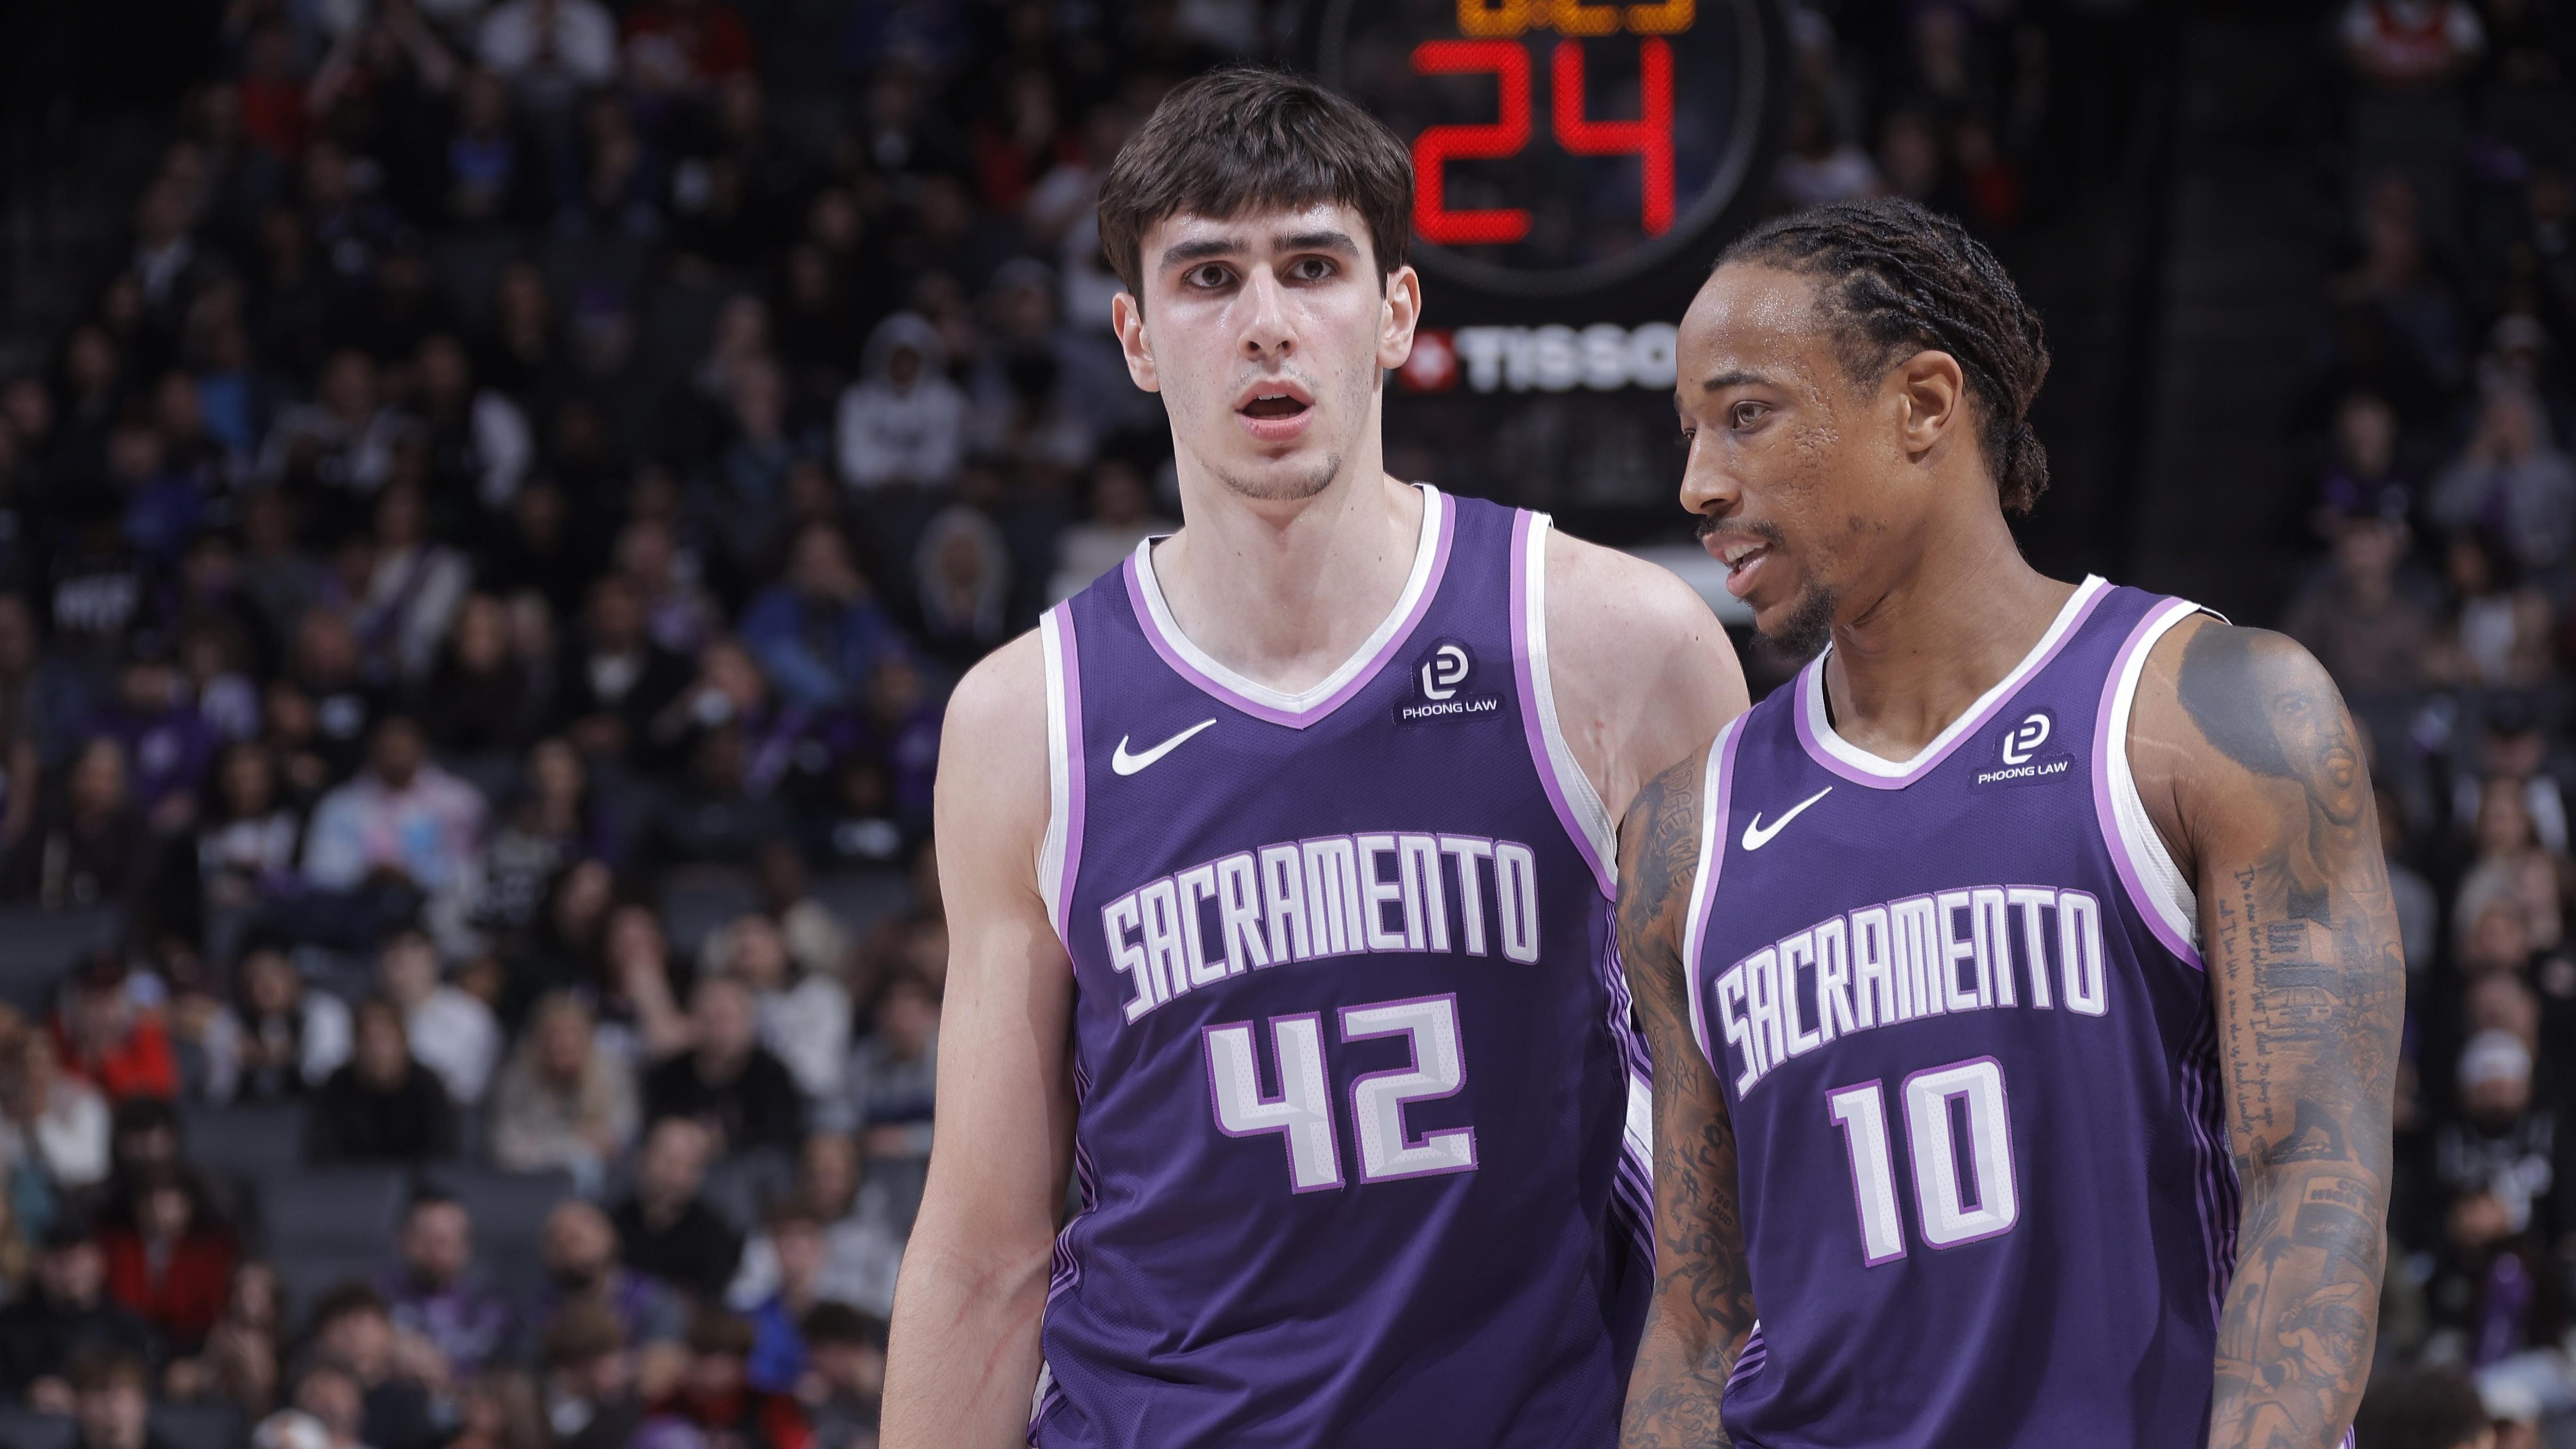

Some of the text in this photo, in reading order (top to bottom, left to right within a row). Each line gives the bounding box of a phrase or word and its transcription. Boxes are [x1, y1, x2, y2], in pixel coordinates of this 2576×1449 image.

[1410, 34, 1675, 245] 24
[1455, 322, 1679, 393] TISSO
[1403, 699, 1497, 720] PHOONG LAW
[1978, 761, 2068, 784] PHOONG LAW
[1100, 831, 1541, 1026] SACRAMENTO
[1714, 883, 2109, 1102] SACRAMENTO
[1201, 992, 1479, 1195] 42
[1825, 1055, 2021, 1268] 10
[1710, 1187, 1730, 1209] TOO
